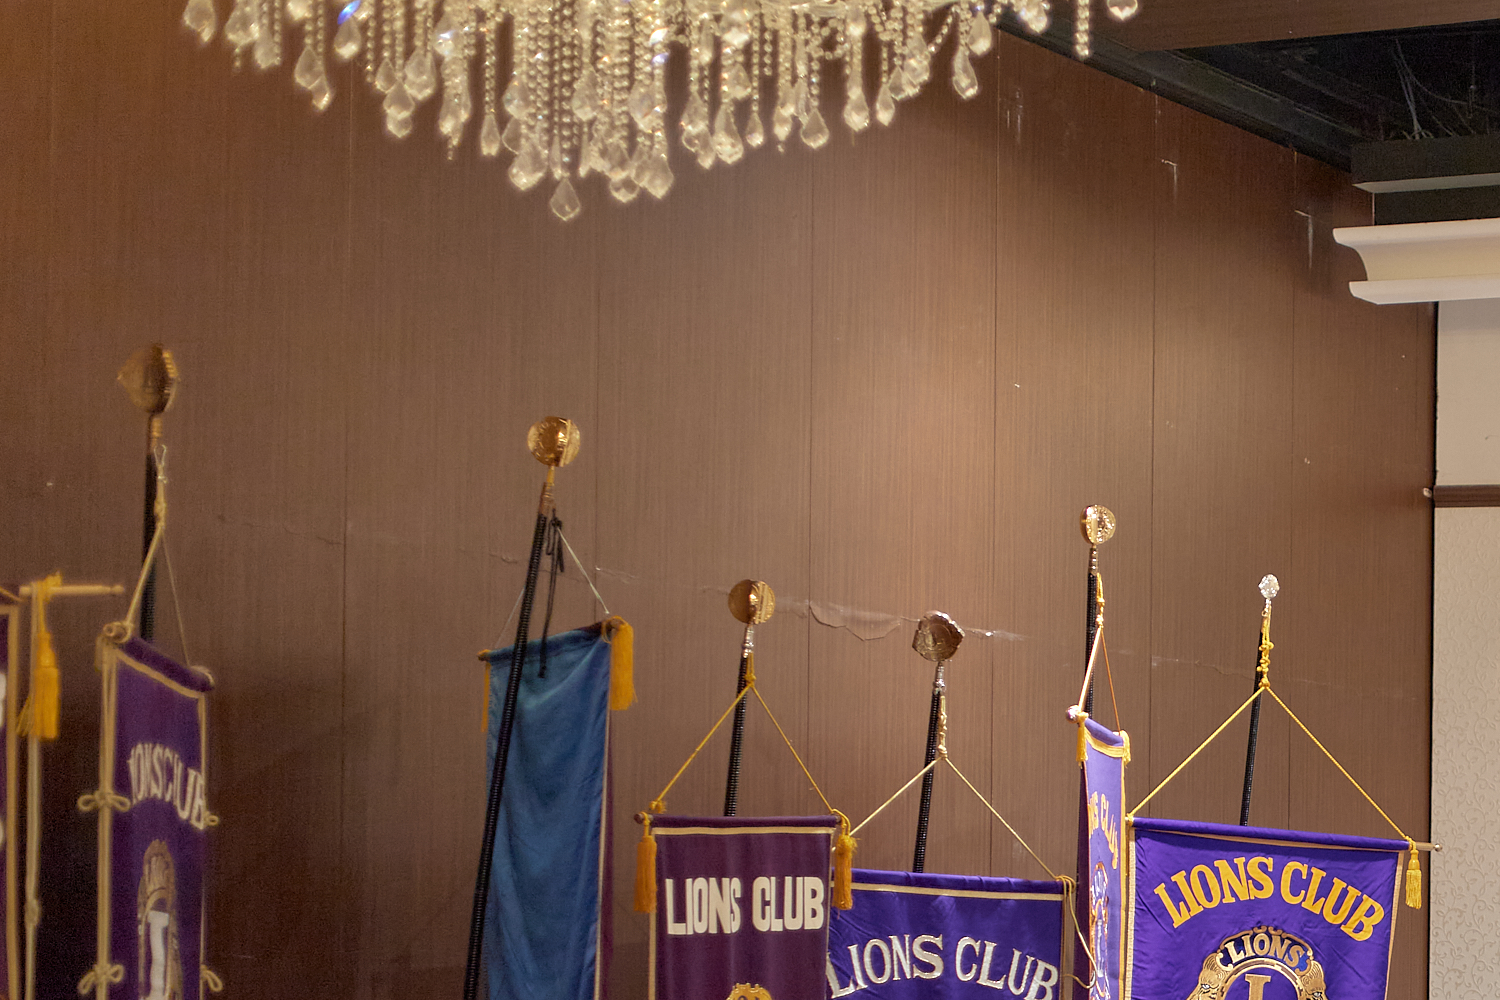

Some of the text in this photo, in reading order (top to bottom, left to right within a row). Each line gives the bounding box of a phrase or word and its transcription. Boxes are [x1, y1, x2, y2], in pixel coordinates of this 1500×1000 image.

[665, 875, 824, 935] LIONS CLUB
[1154, 856, 1274, 929] LIONS
[1280, 861, 1385, 941] CLUB
[826, 933, 945, 1000] LIONS
[1225, 933, 1305, 968] LIONS
